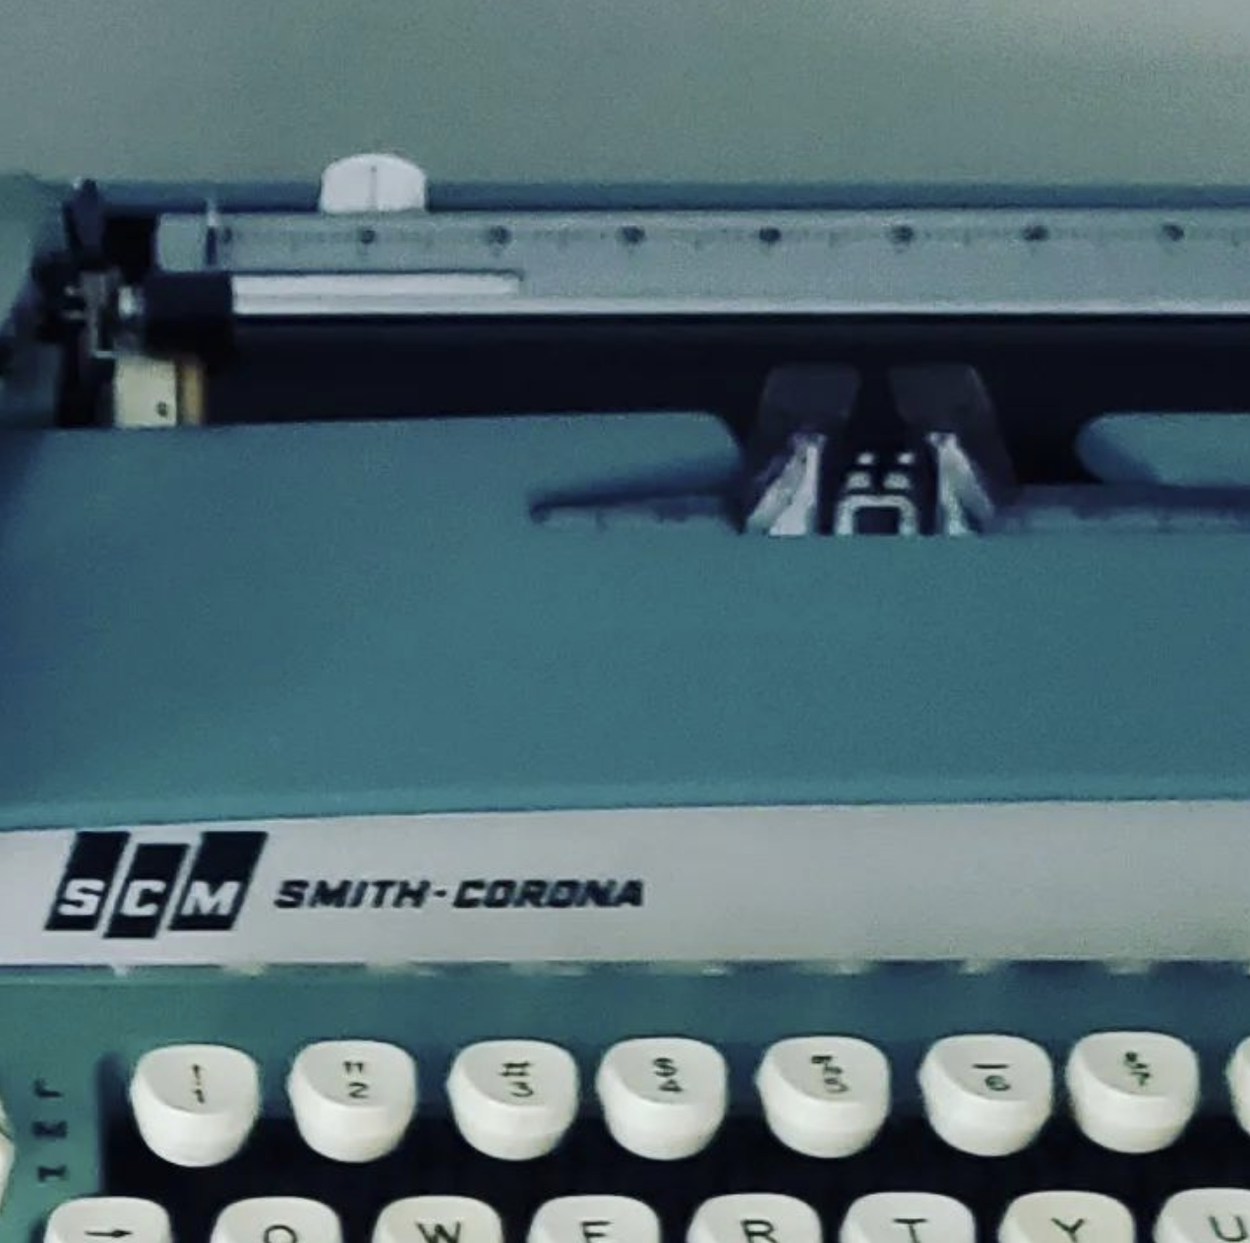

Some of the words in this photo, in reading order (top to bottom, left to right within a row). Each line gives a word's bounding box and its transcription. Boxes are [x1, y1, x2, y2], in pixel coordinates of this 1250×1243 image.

[58, 880, 241, 917] SCM
[273, 879, 644, 909] SMITH-CORONA
[652, 1057, 678, 1078] $
[348, 1081, 369, 1099] 2
[511, 1081, 535, 1098] 3
[658, 1078, 684, 1094] 4
[823, 1076, 849, 1094] 5
[983, 1074, 1012, 1092] 6
[1051, 1217, 1085, 1243] Y
[1208, 1215, 1249, 1243] U
